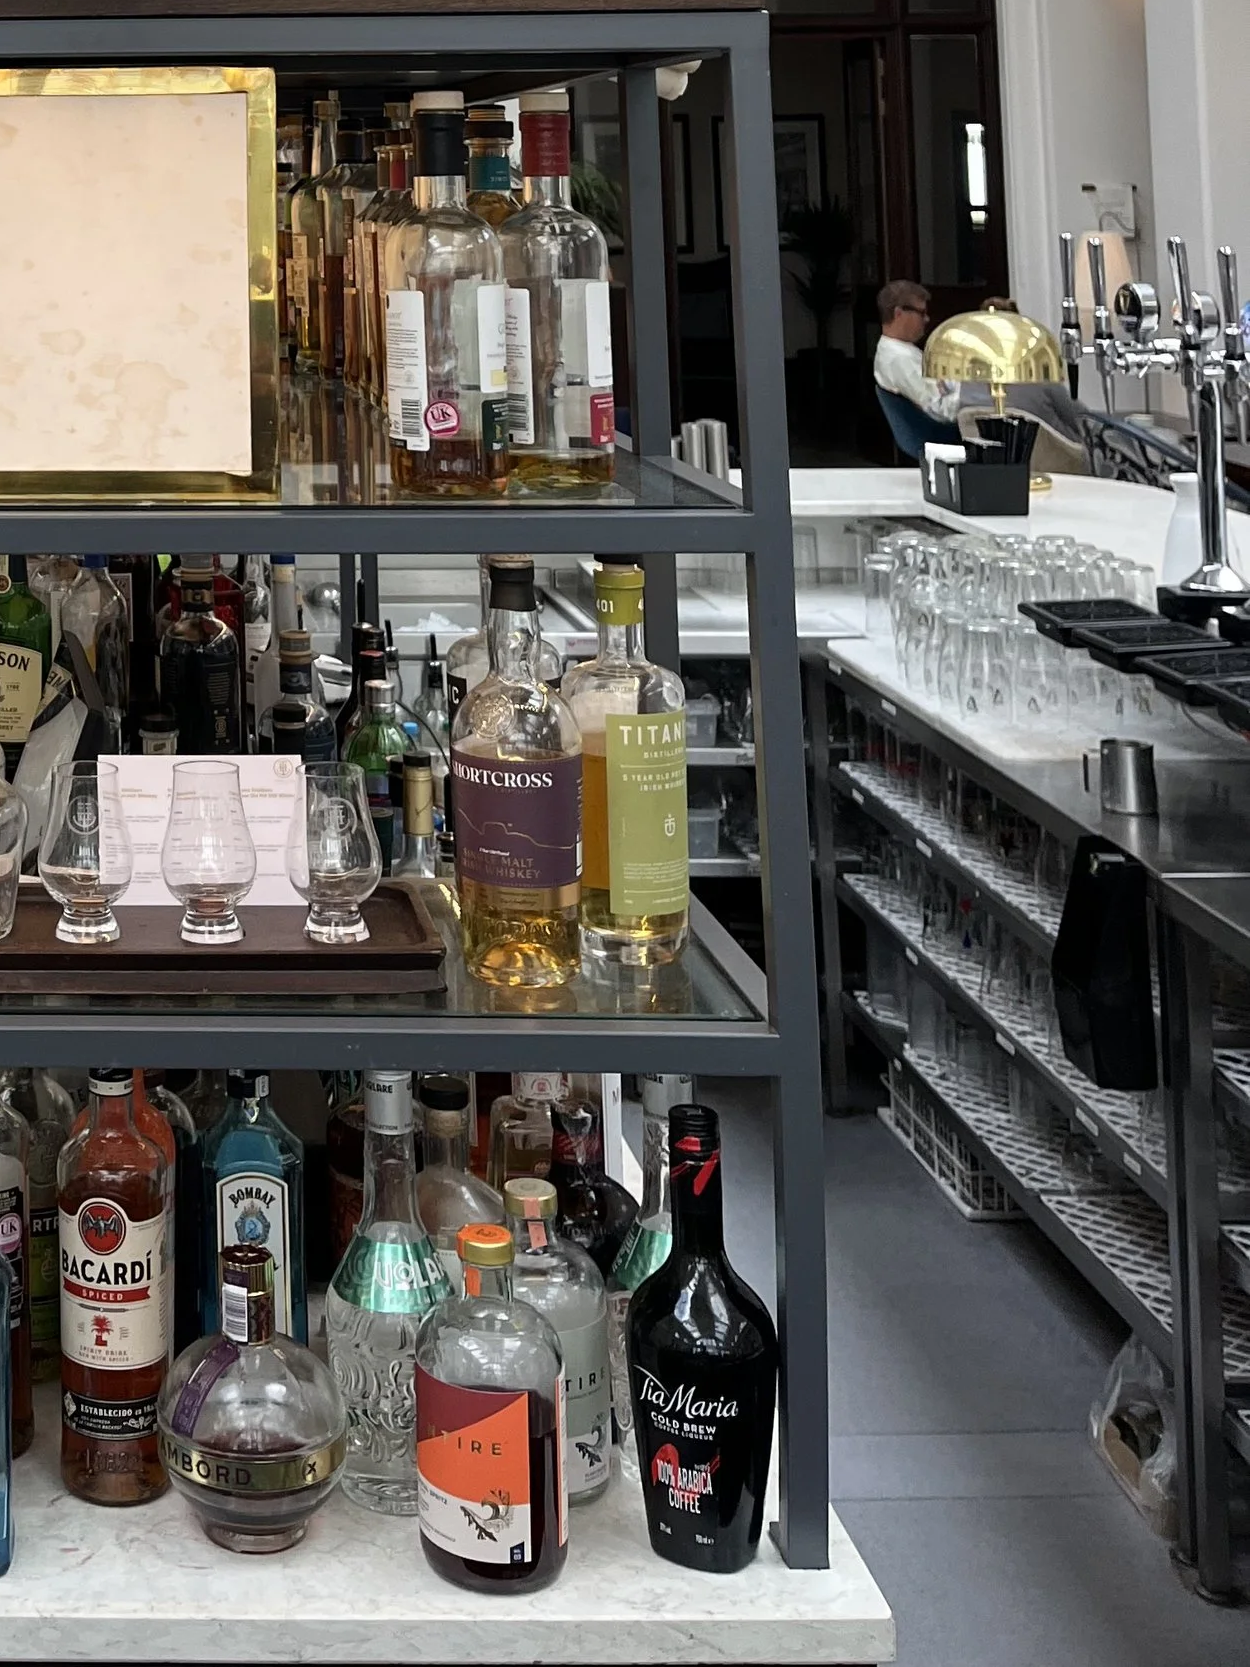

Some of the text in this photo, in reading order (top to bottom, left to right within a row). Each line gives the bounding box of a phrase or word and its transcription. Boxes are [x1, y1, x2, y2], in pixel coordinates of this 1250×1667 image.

[430, 408, 451, 421] UK
[502, 857, 534, 868] MALT
[486, 866, 541, 880] WHISKEY
[228, 1186, 276, 1209] BOMBAY
[0, 1222, 18, 1236] UK
[62, 1246, 152, 1285] BACARDÍ
[82, 1288, 124, 1301] SPICED
[633, 1364, 738, 1419] Tia Maria
[80, 1404, 132, 1417] ESTABLECIDO
[651, 1411, 716, 1435] COLD BREW
[681, 1430, 714, 1441] LIQUEUR
[160, 1436, 251, 1486] AMBORD
[657, 1458, 714, 1496] 100% ARABICA
[668, 1487, 701, 1514] COFFEE
